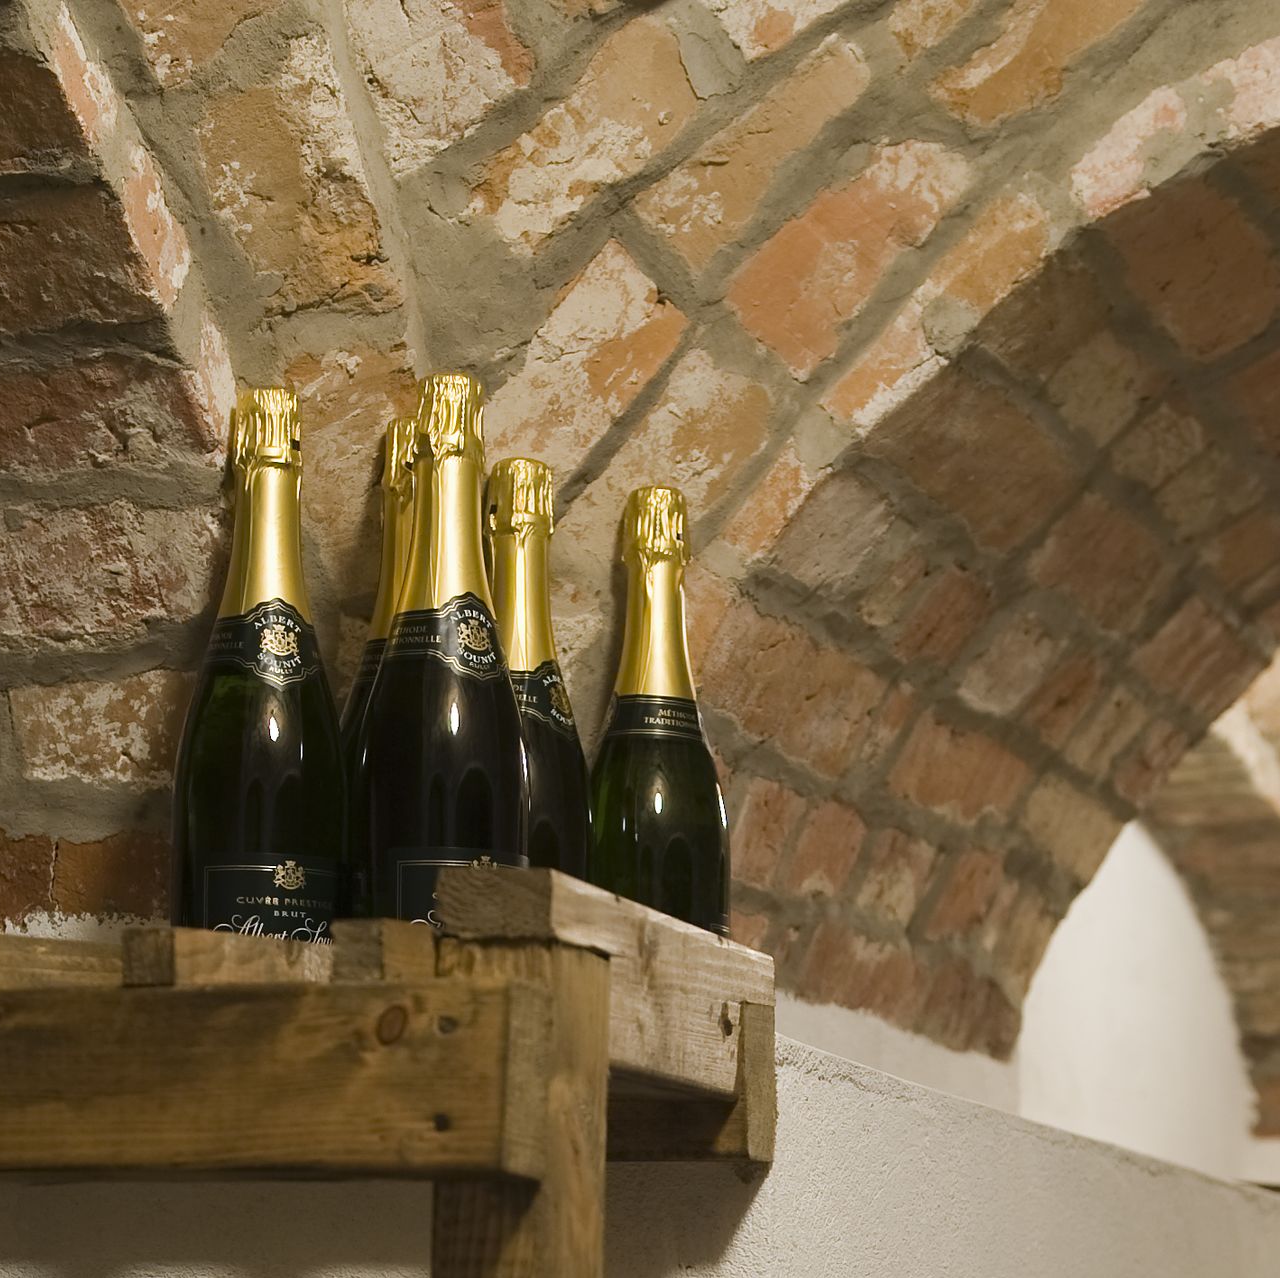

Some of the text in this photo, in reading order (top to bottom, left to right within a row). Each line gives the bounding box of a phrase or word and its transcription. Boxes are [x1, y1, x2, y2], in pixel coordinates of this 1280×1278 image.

[253, 614, 302, 633] ALBERT
[448, 608, 493, 629] ALBERT
[257, 653, 302, 669] SOUNIT
[457, 648, 497, 664] SOUNIT
[236, 895, 280, 906] CUVÉE
[273, 909, 307, 919] BRUT
